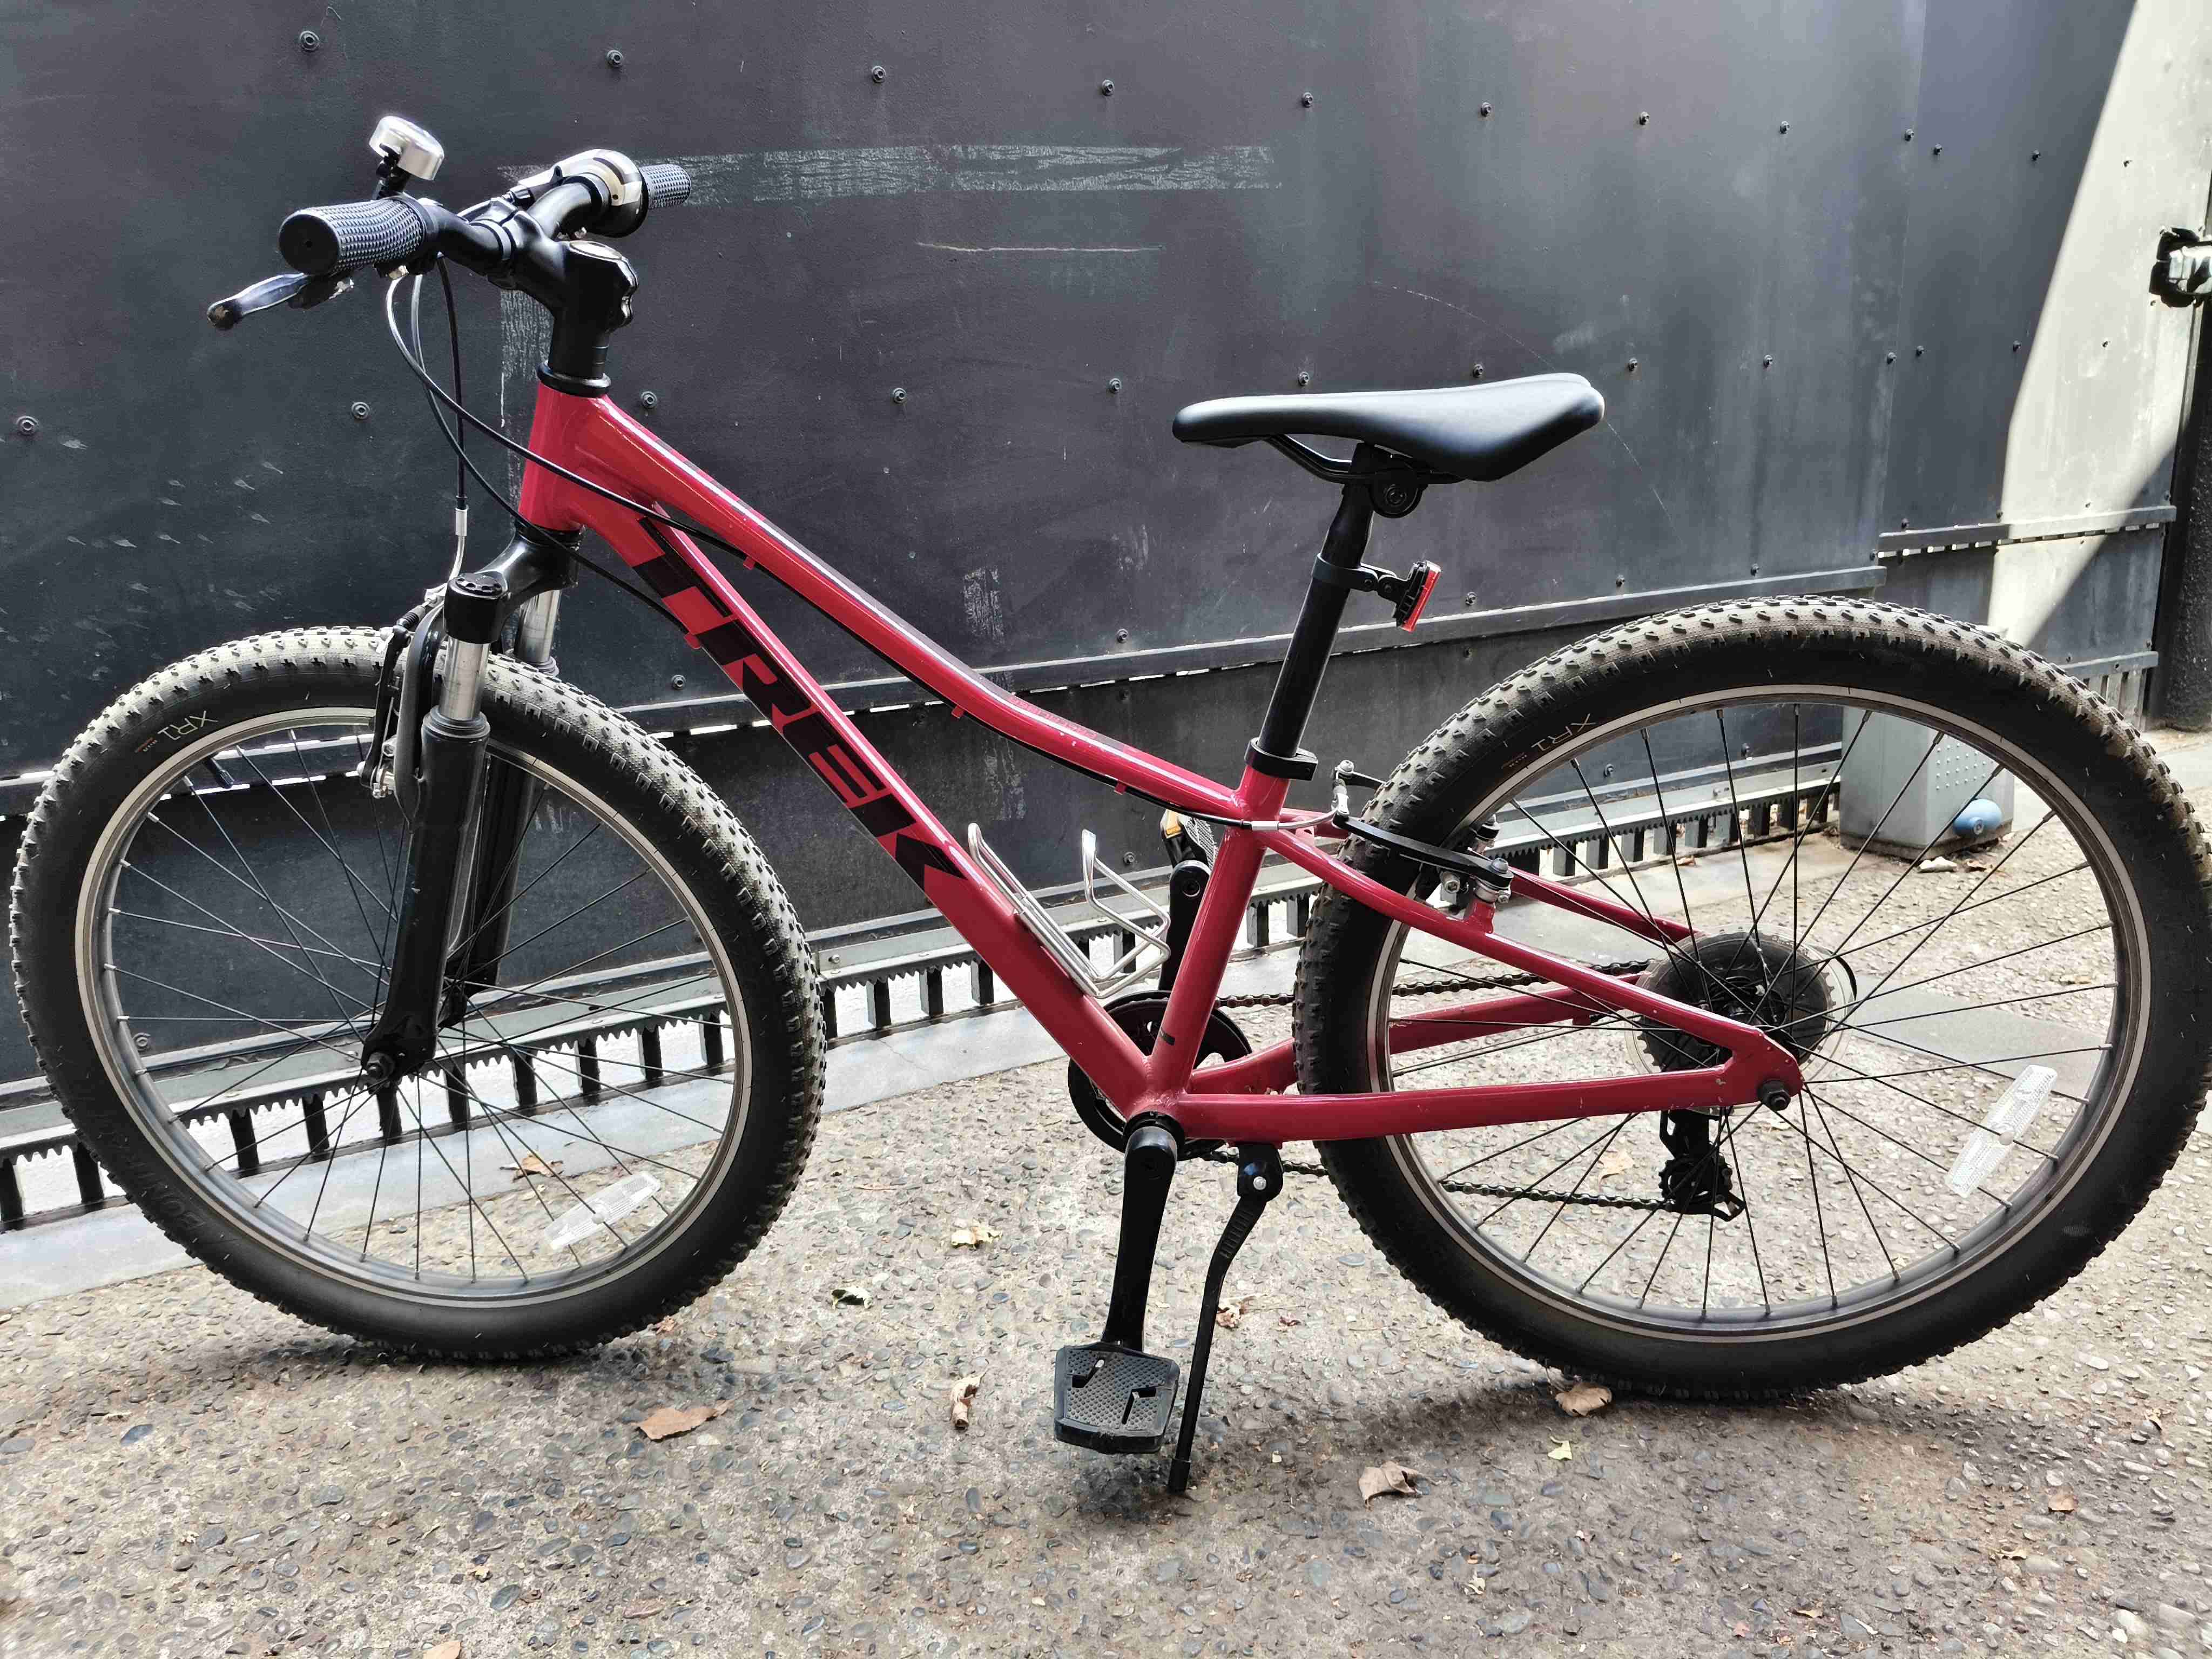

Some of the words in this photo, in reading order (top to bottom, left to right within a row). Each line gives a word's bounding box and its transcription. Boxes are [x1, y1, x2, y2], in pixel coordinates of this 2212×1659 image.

[632, 517, 968, 891] TREK
[157, 710, 220, 740] XR1
[1530, 713, 1597, 751] XR1
